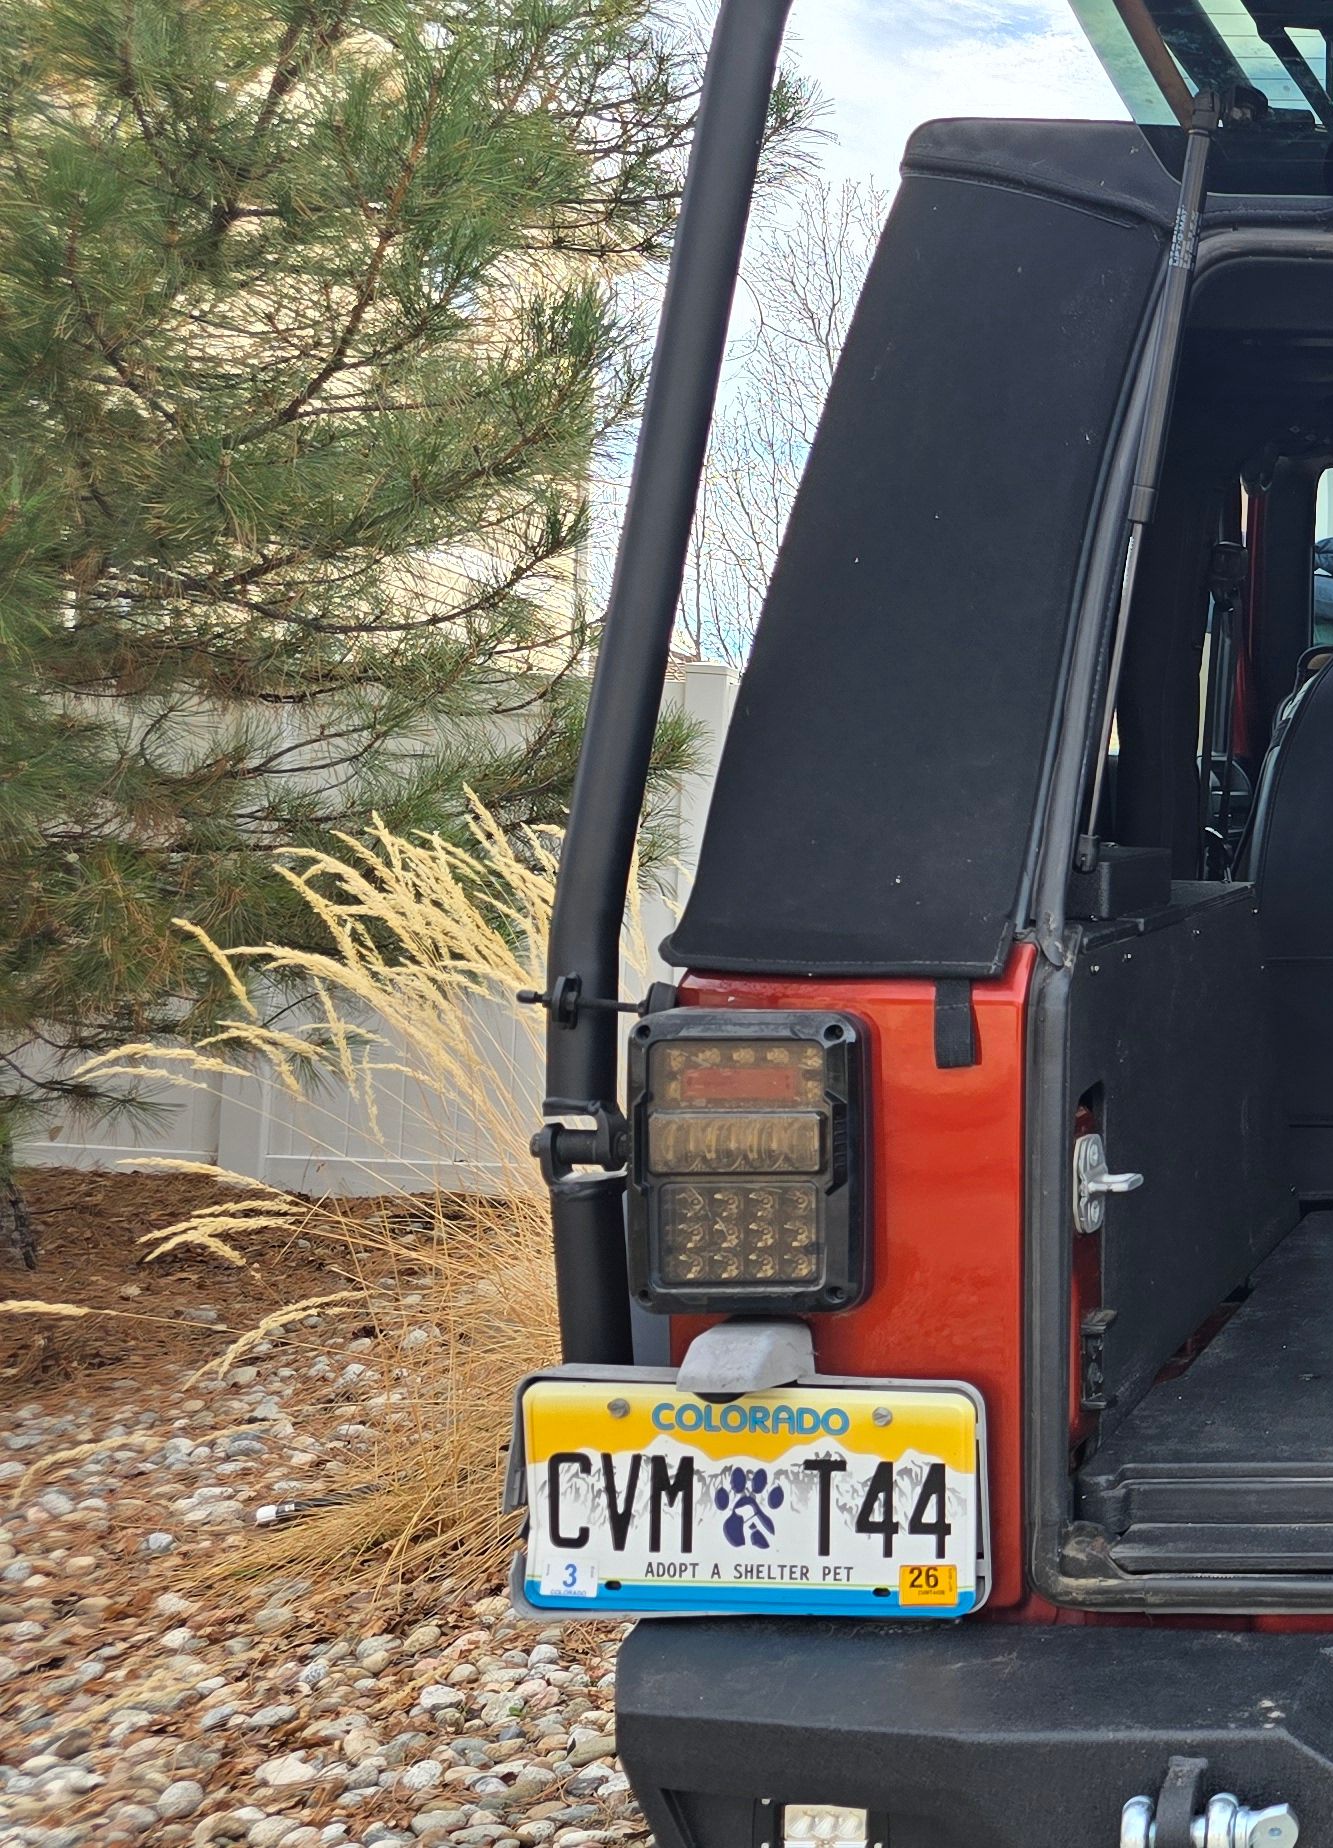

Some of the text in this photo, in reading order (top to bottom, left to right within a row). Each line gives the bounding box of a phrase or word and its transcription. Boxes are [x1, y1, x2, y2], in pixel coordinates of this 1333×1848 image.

[651, 1402, 851, 1436] COLORADO
[547, 1452, 952, 1559] CVM T44
[562, 1563, 577, 1588] 3
[644, 1561, 854, 1582] ADOPT A SHELTER PET
[908, 1566, 939, 1589] 26
